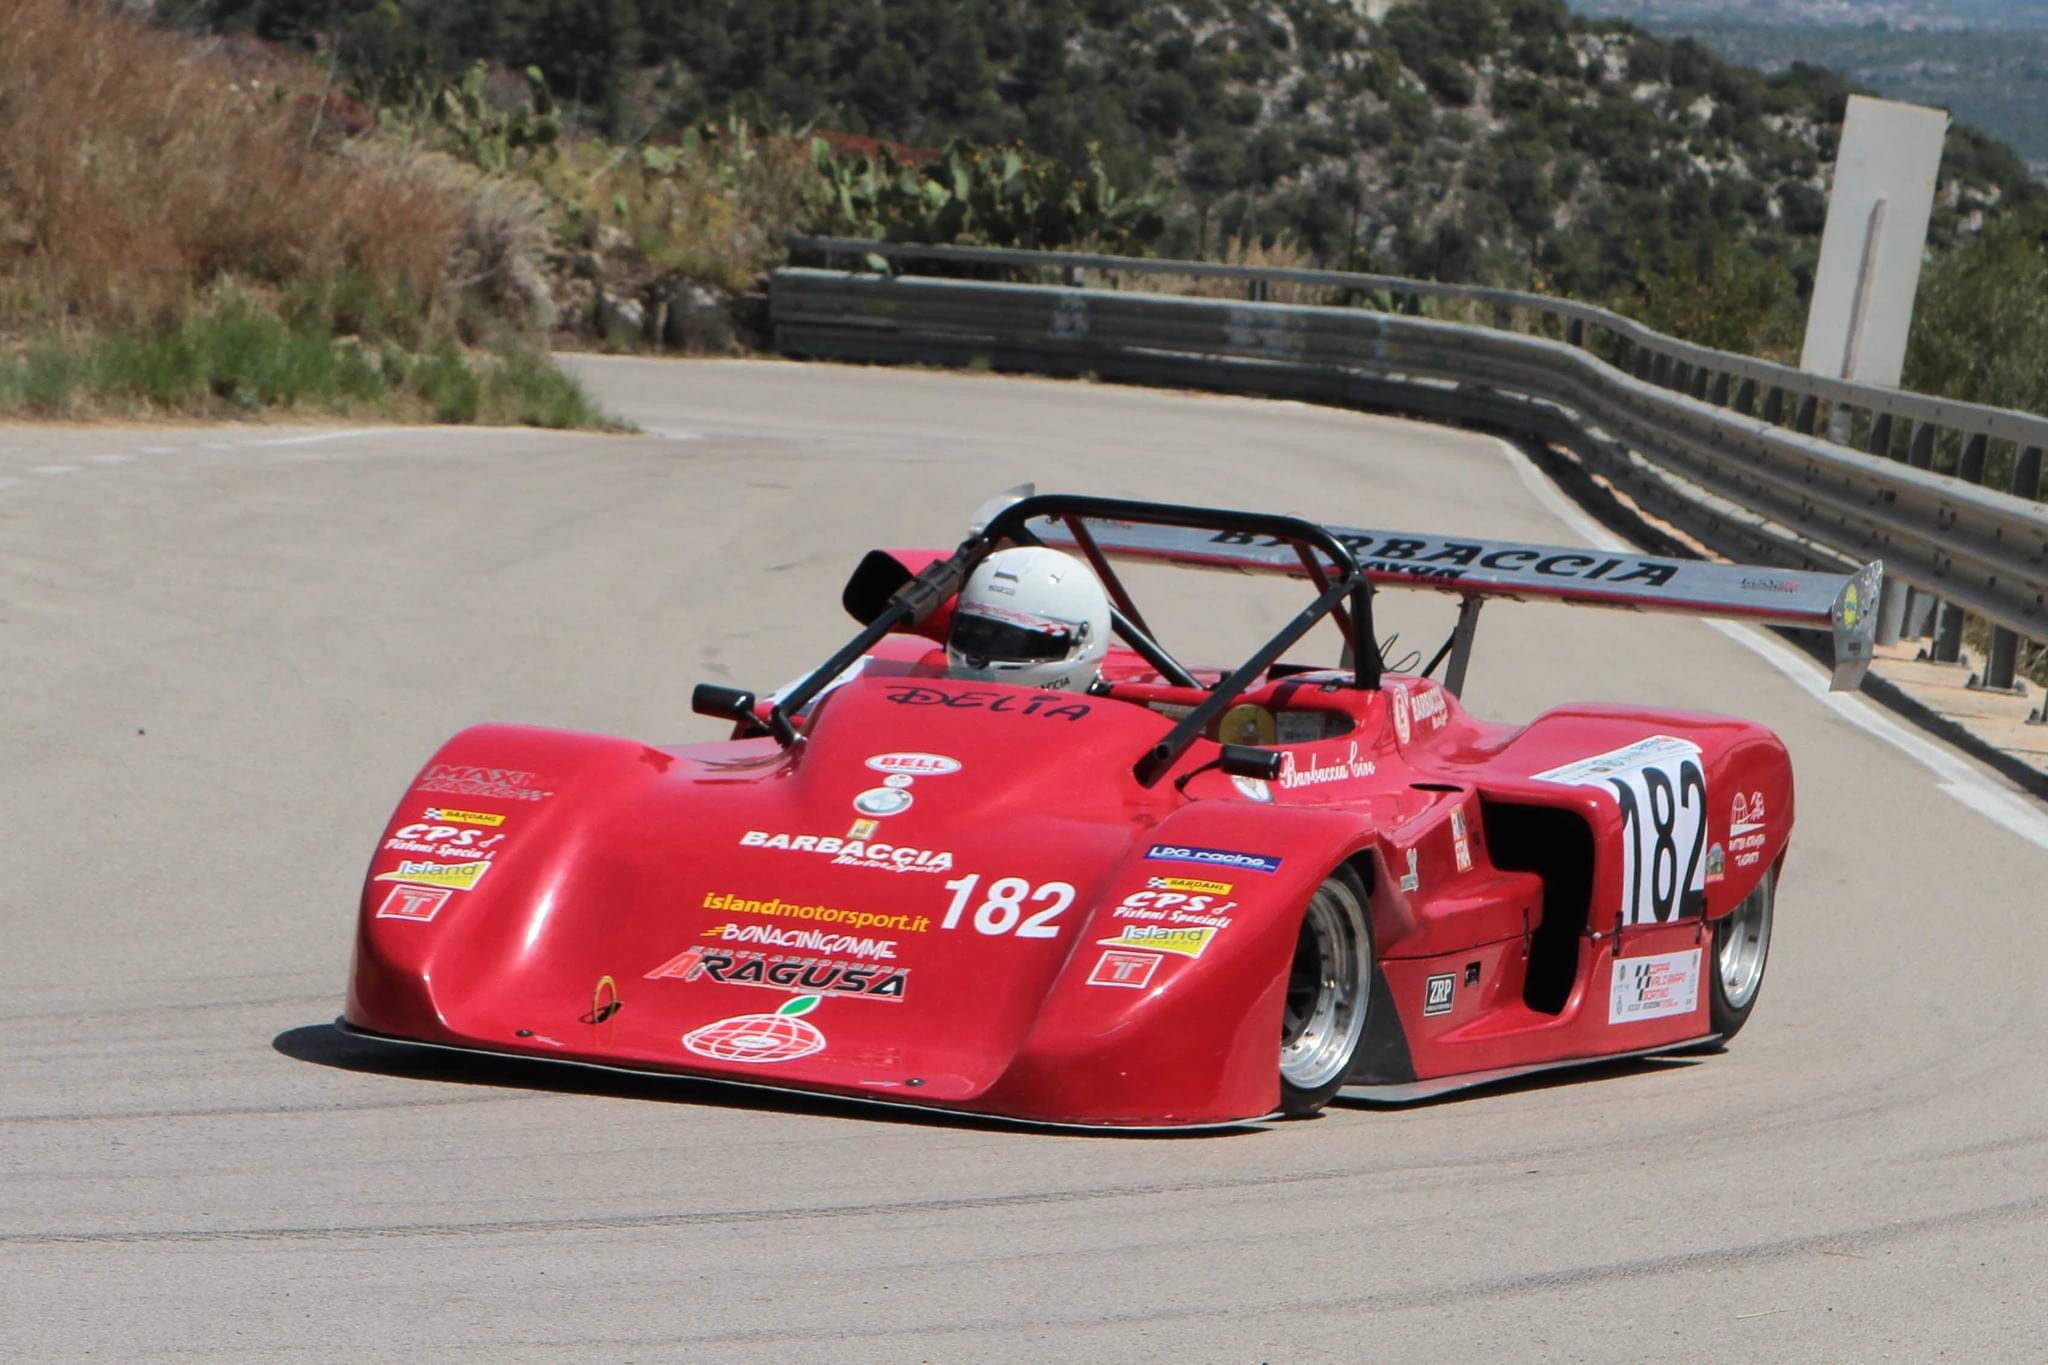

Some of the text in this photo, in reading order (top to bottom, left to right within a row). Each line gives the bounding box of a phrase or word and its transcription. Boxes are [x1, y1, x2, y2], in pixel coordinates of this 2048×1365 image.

[1209, 528, 1679, 587] BRBACCIA
[885, 686, 1091, 721] DELTA
[880, 757, 946, 770] BELL
[395, 823, 482, 845] CPS
[1606, 760, 1707, 922] 182
[740, 831, 953, 869] BARBACCIA
[1150, 846, 1191, 858] LPG
[400, 861, 478, 876] Island
[1169, 878, 1227, 892] BARDAHL
[703, 892, 930, 932] islandmotorsport.it
[941, 874, 1076, 938] 182
[1123, 891, 1216, 912] CPS
[1124, 926, 1204, 942] Island
[1429, 979, 1452, 1004] ZRP
